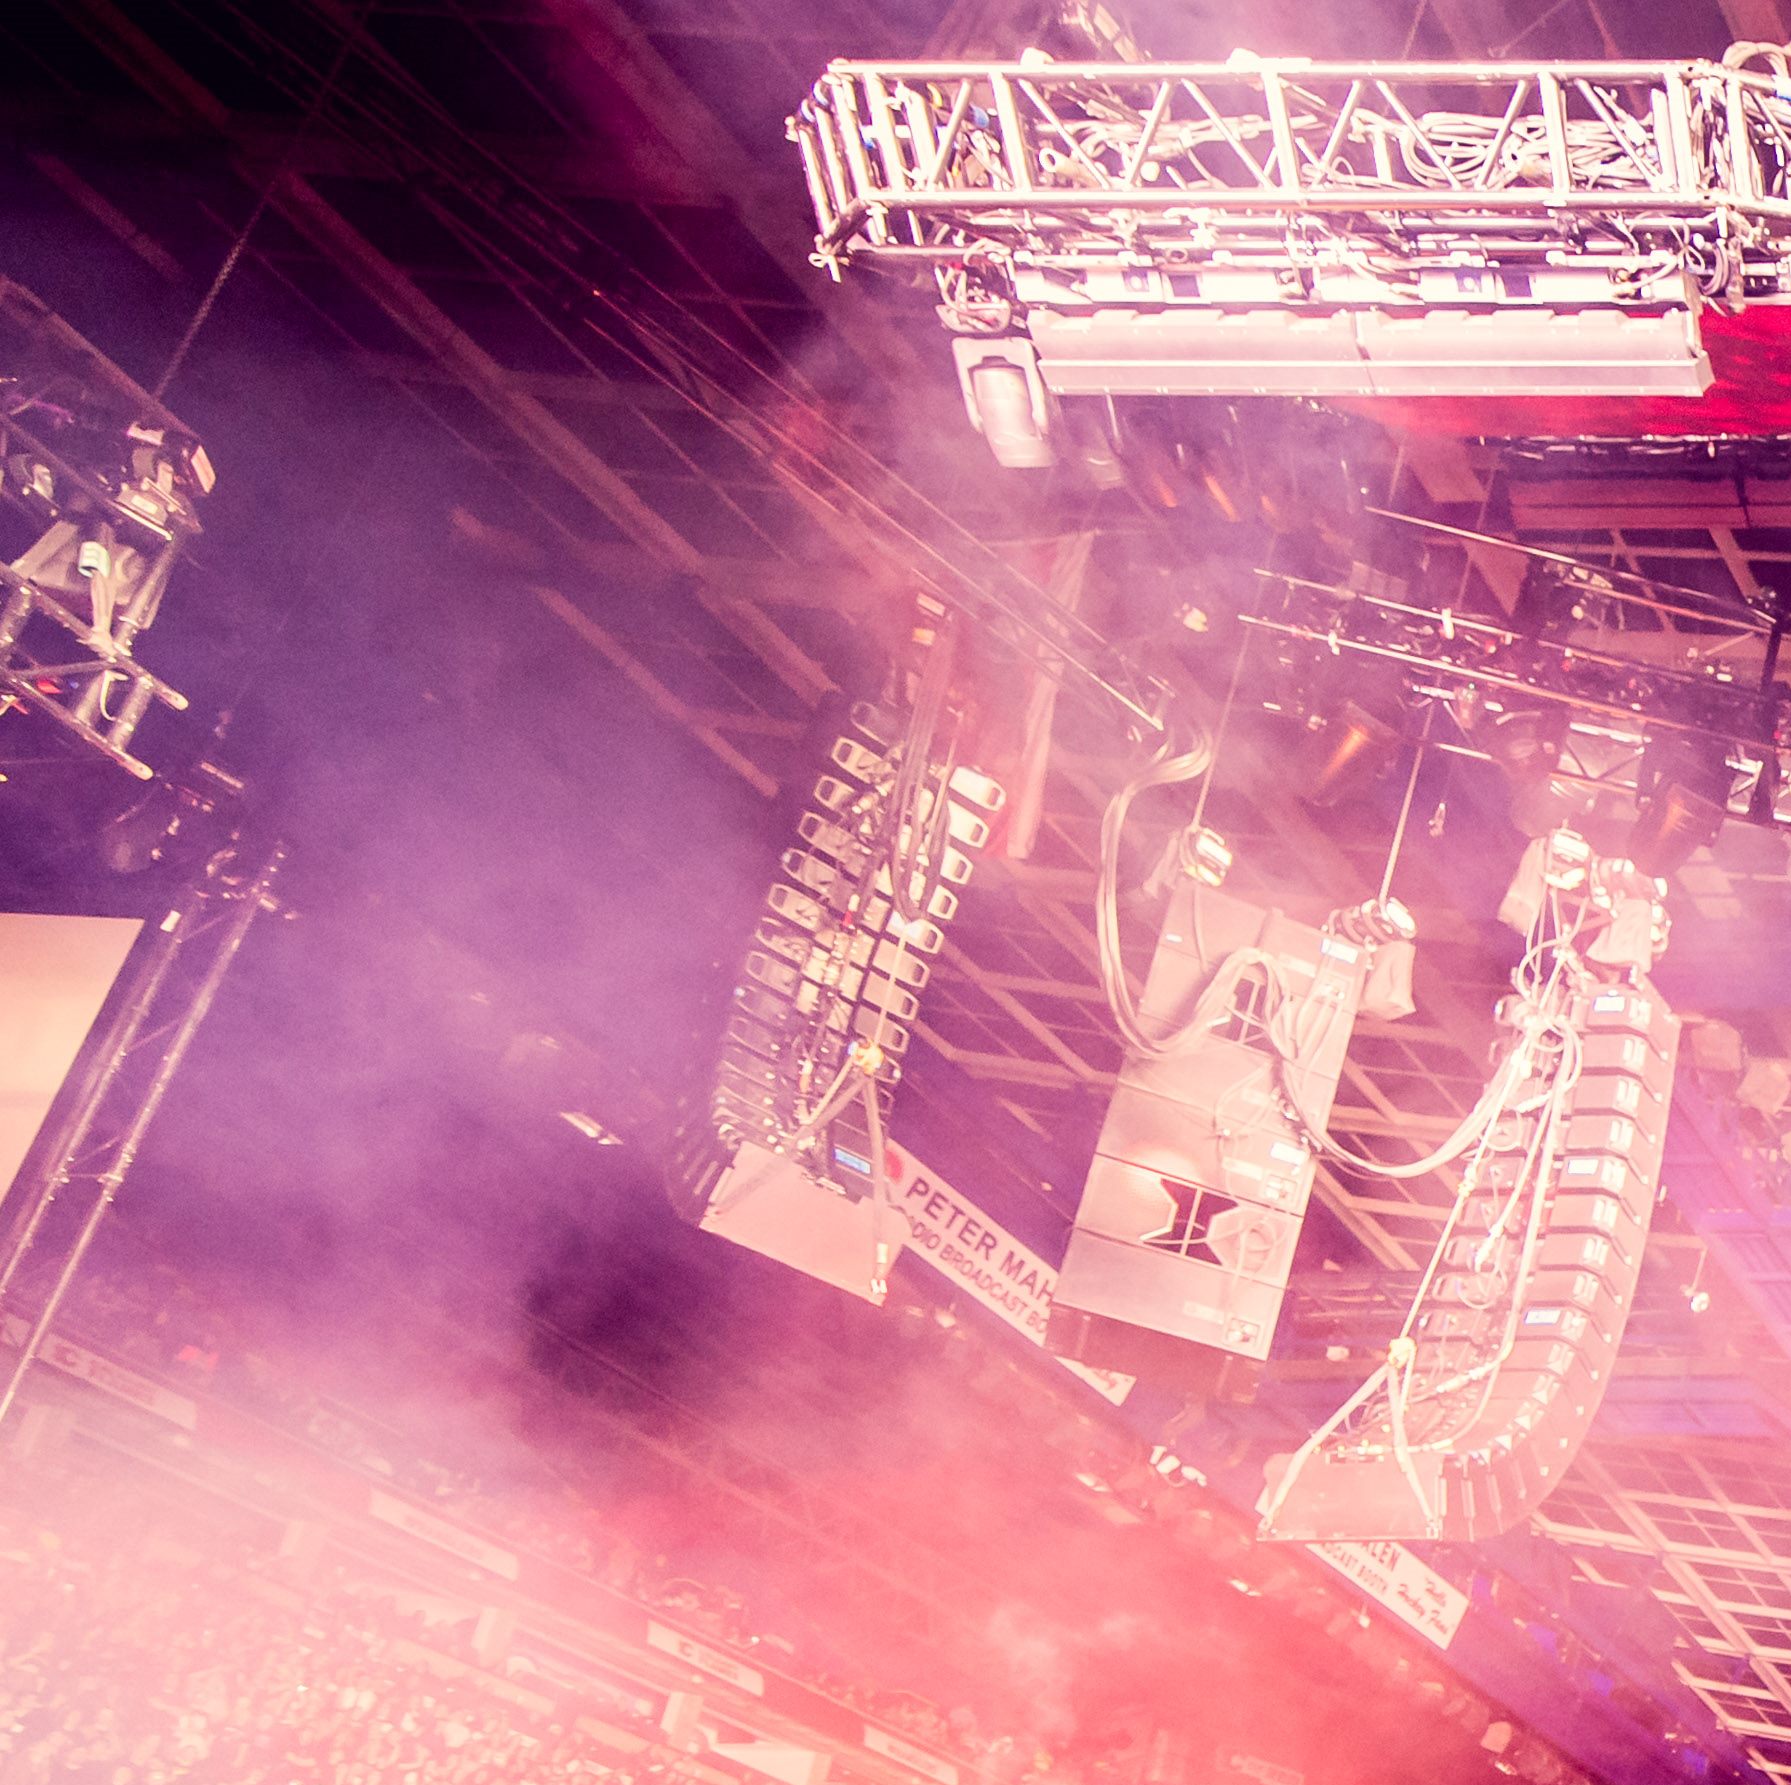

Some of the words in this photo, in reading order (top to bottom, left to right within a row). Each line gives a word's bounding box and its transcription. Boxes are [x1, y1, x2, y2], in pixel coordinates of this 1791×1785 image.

[905, 1177, 998, 1261] PETER
[908, 1216, 941, 1250] DIO
[938, 1245, 1030, 1318] BROADCAST
